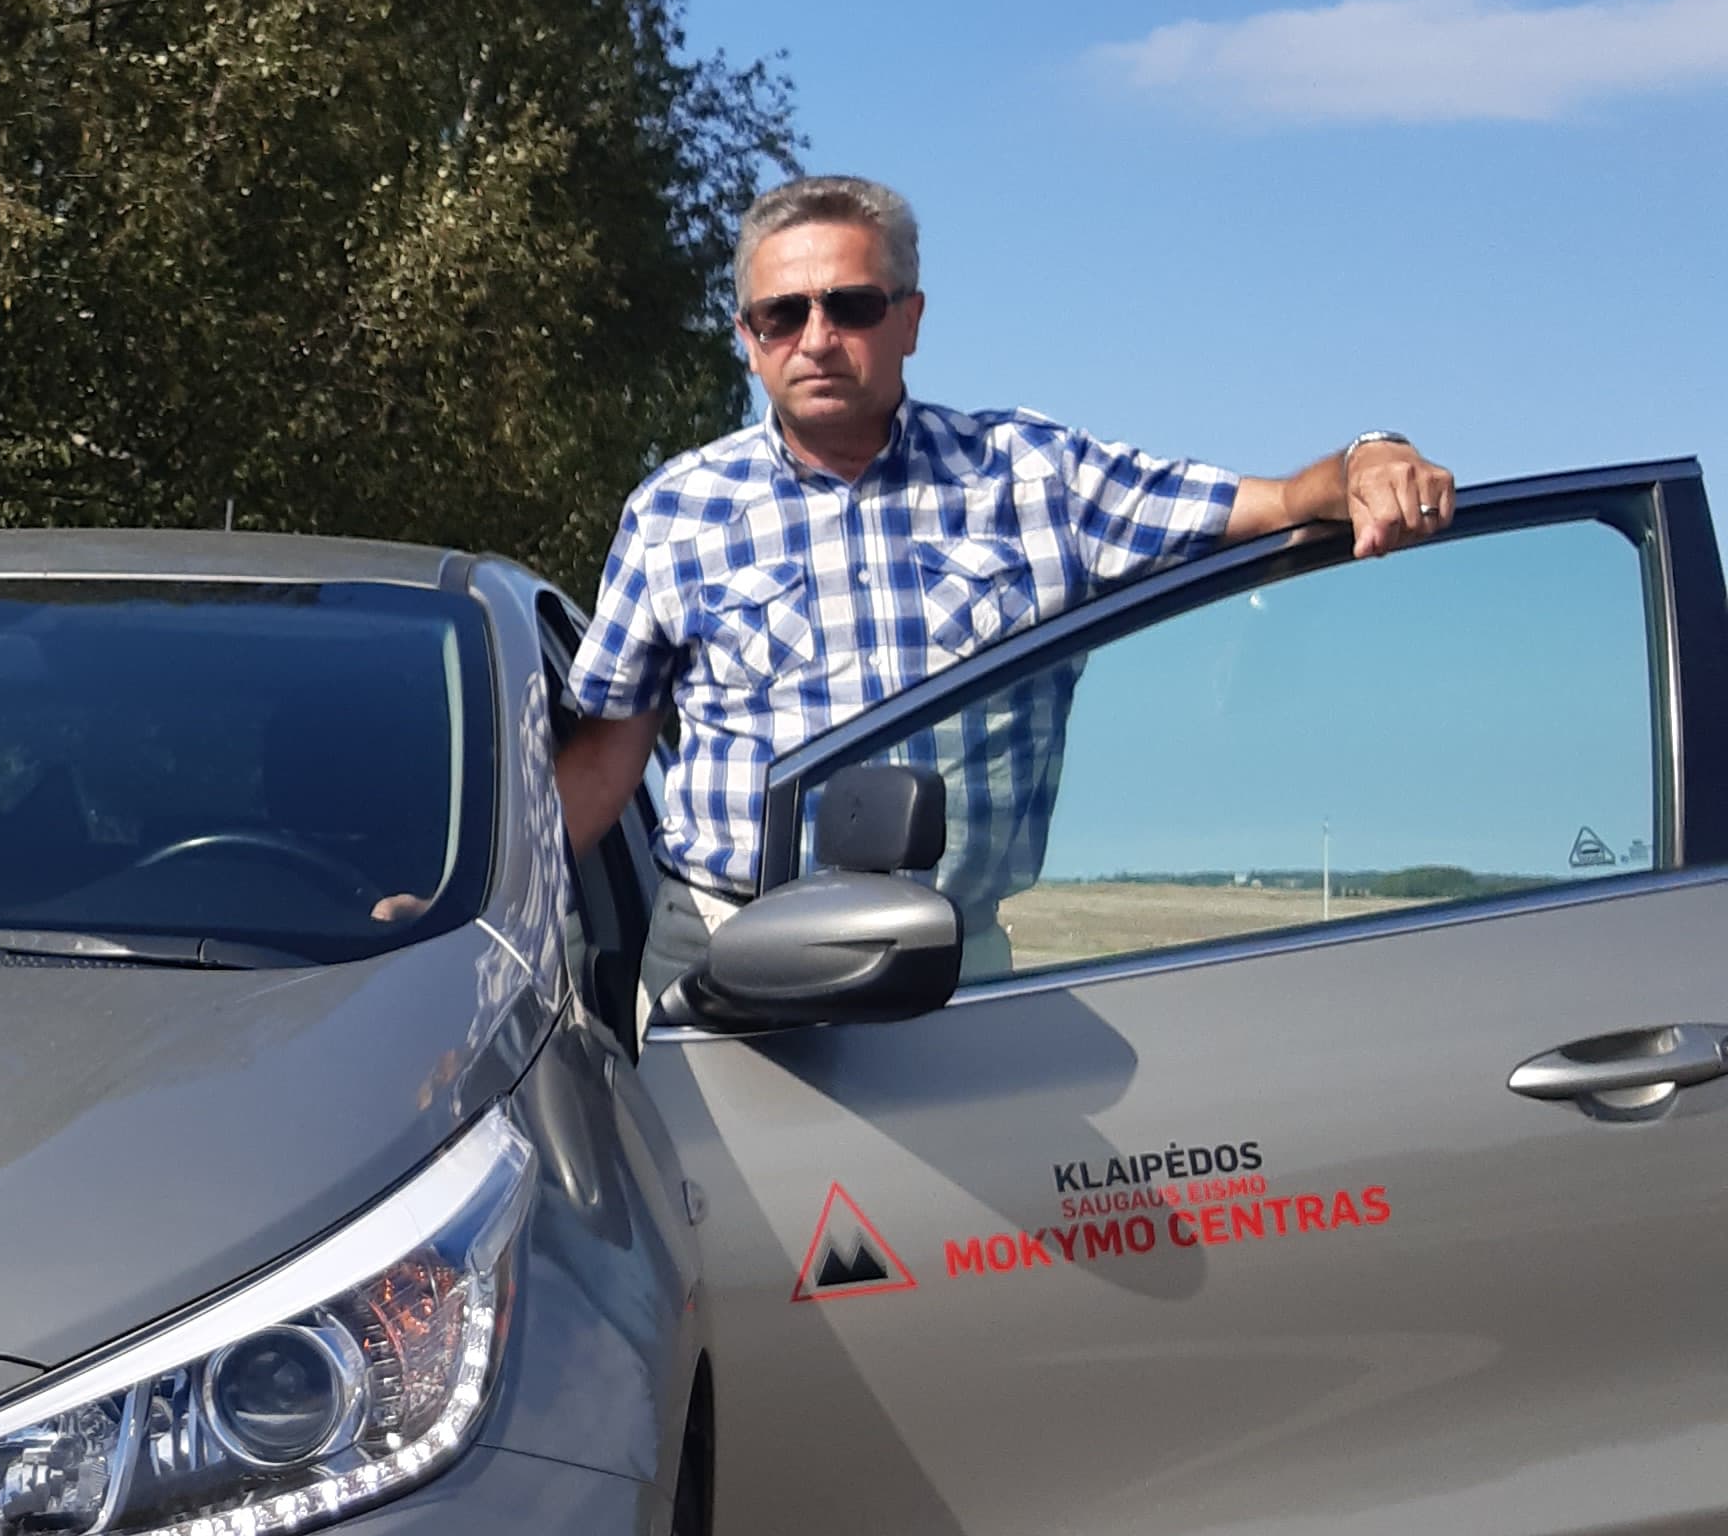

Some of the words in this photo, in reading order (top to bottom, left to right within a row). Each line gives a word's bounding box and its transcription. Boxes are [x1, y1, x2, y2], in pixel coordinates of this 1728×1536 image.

[1053, 1141, 1263, 1193] KLAIPĖDOS
[1061, 1184, 1182, 1219] SAUGAUS
[1186, 1173, 1268, 1205] EISMO
[943, 1214, 1157, 1279] MOKYMO
[1167, 1185, 1392, 1249] CENTRAS
